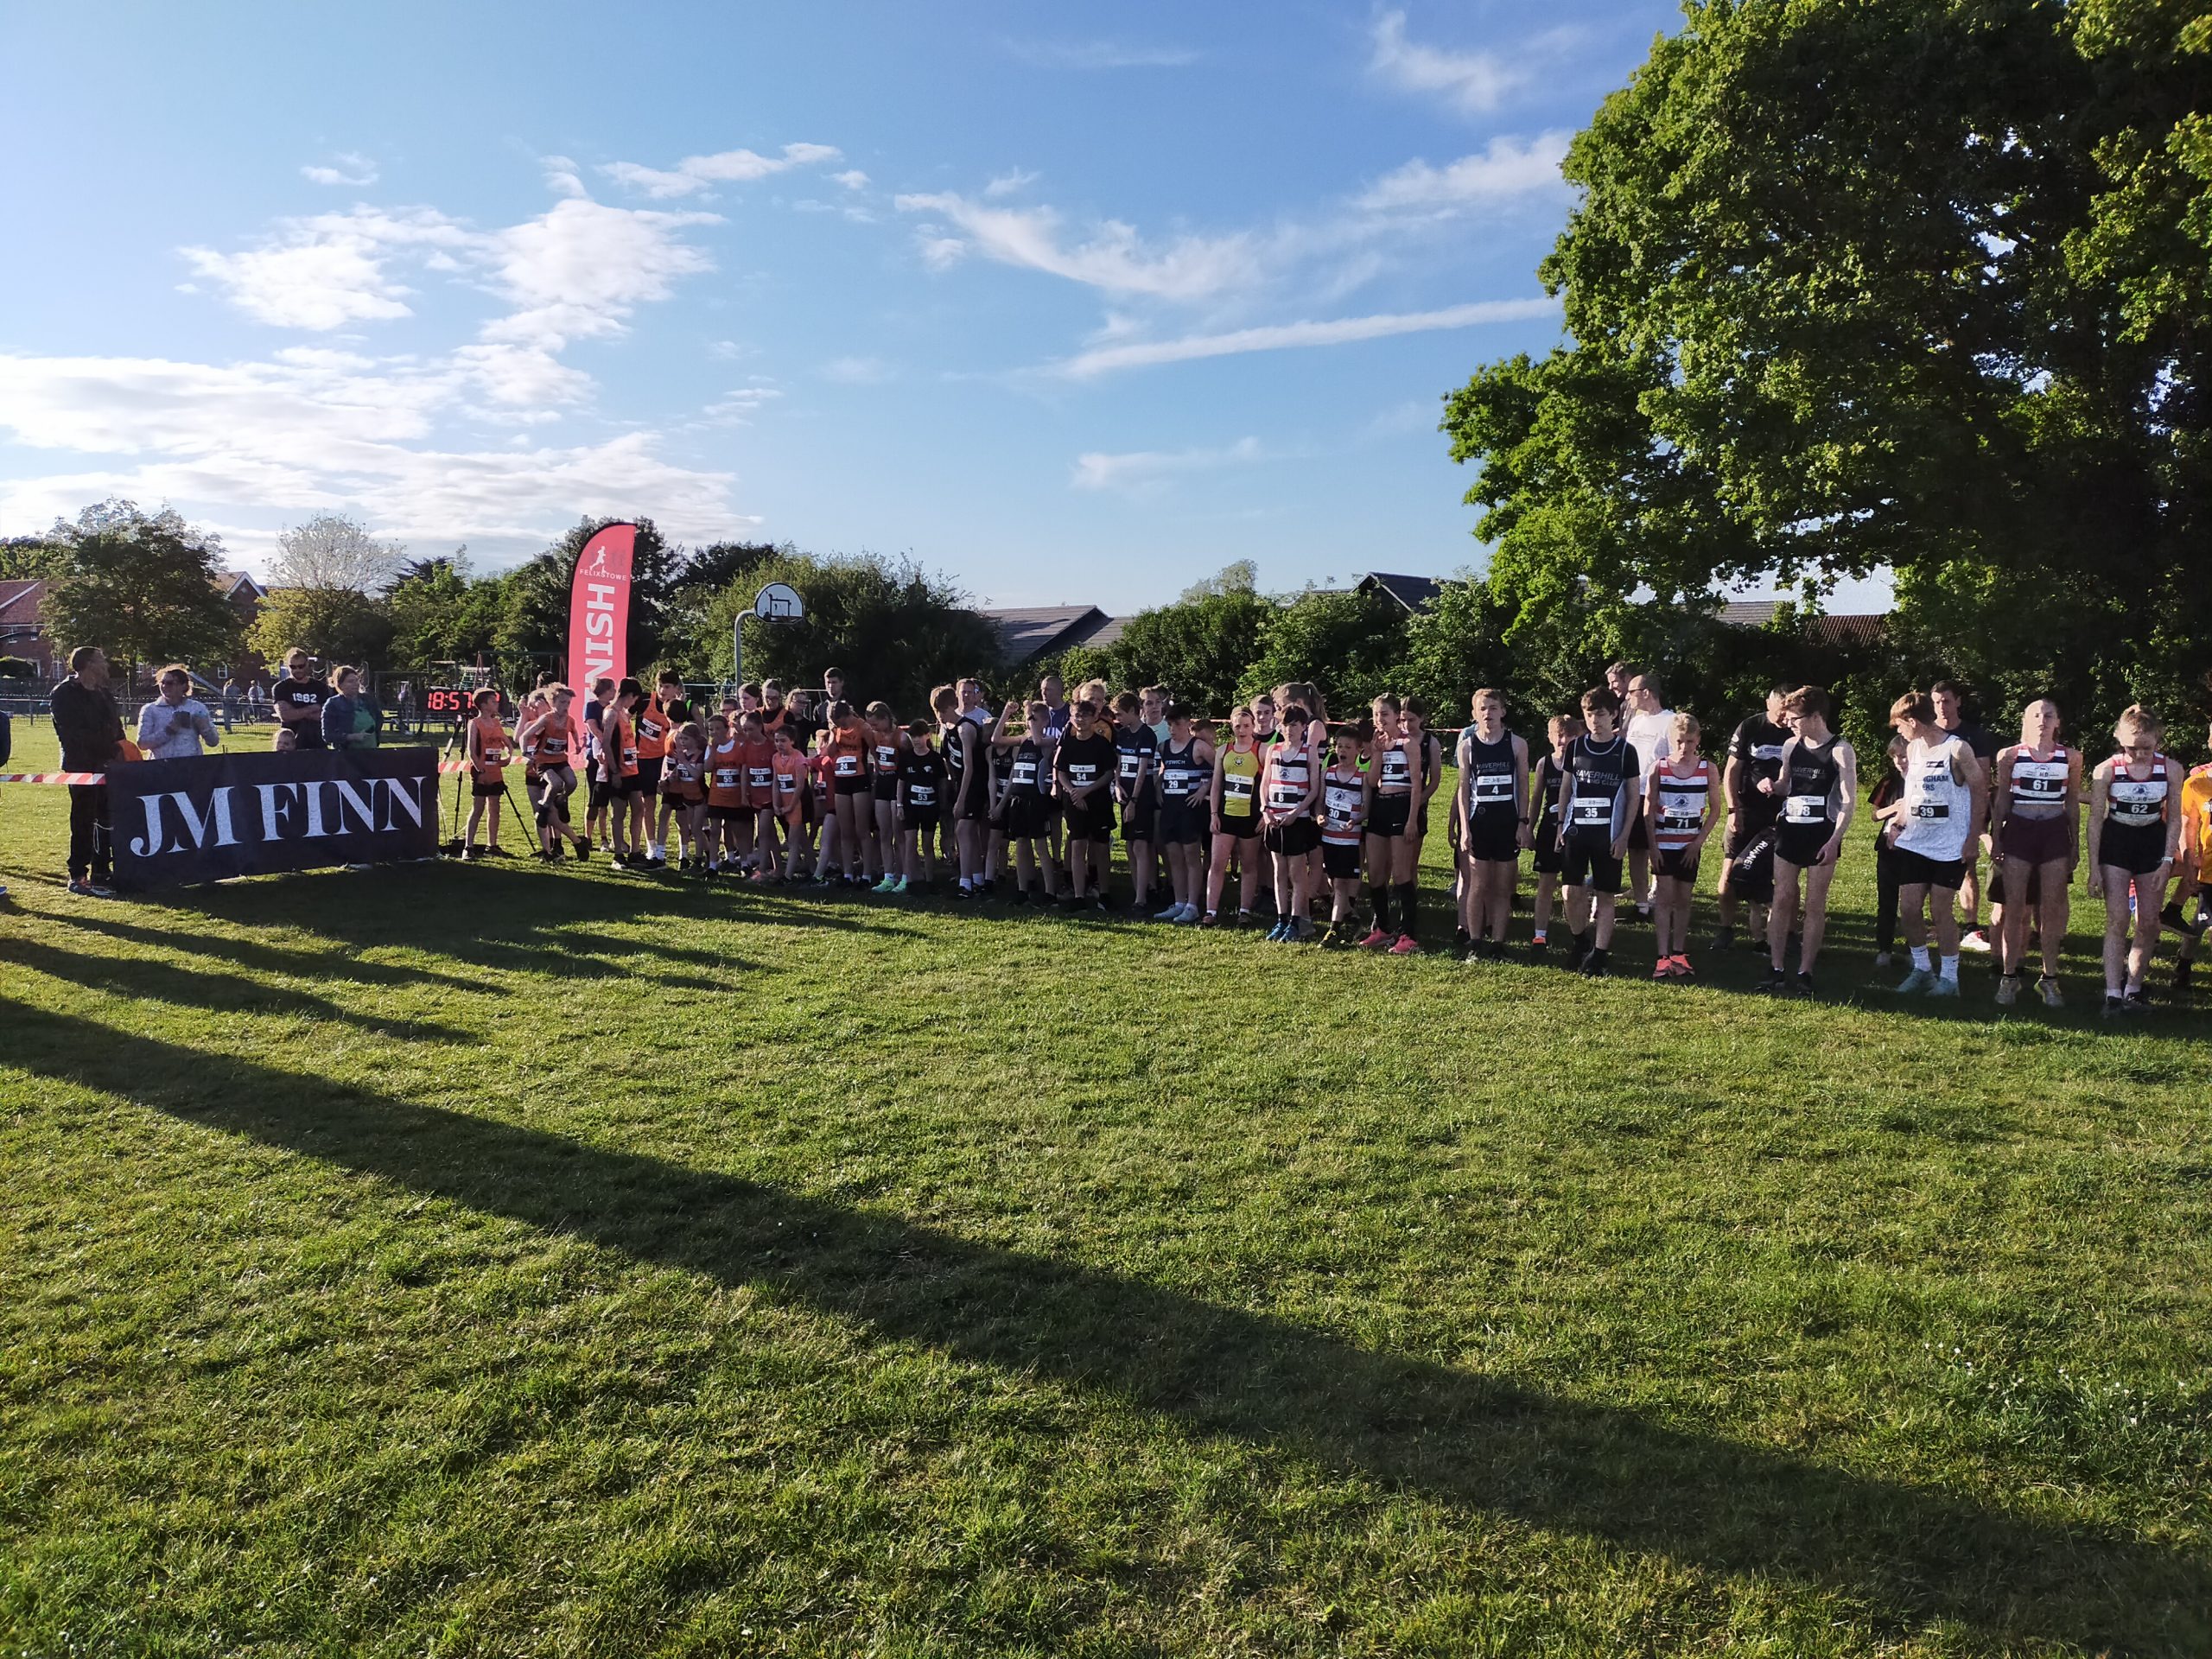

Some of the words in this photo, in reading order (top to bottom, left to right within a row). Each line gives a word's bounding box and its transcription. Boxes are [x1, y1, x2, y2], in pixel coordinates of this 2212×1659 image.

[580, 569, 627, 581] FELIXSTOWE
[582, 582, 615, 720] NISH
[292, 692, 317, 702] 1982
[1382, 765, 1393, 774] 42
[1077, 772, 1086, 781] 54
[1169, 780, 1179, 789] 29
[1491, 785, 1499, 794] 4
[2033, 779, 2048, 791] 61
[1329, 808, 1339, 819] 30
[1585, 808, 1599, 817] 35
[1919, 806, 1935, 817] 39
[2131, 804, 2149, 814] 62
[130, 785, 243, 858] JM
[251, 776, 428, 842] FINN
[1676, 818, 1689, 828] 71
[1743, 840, 1769, 870] RUNNER
